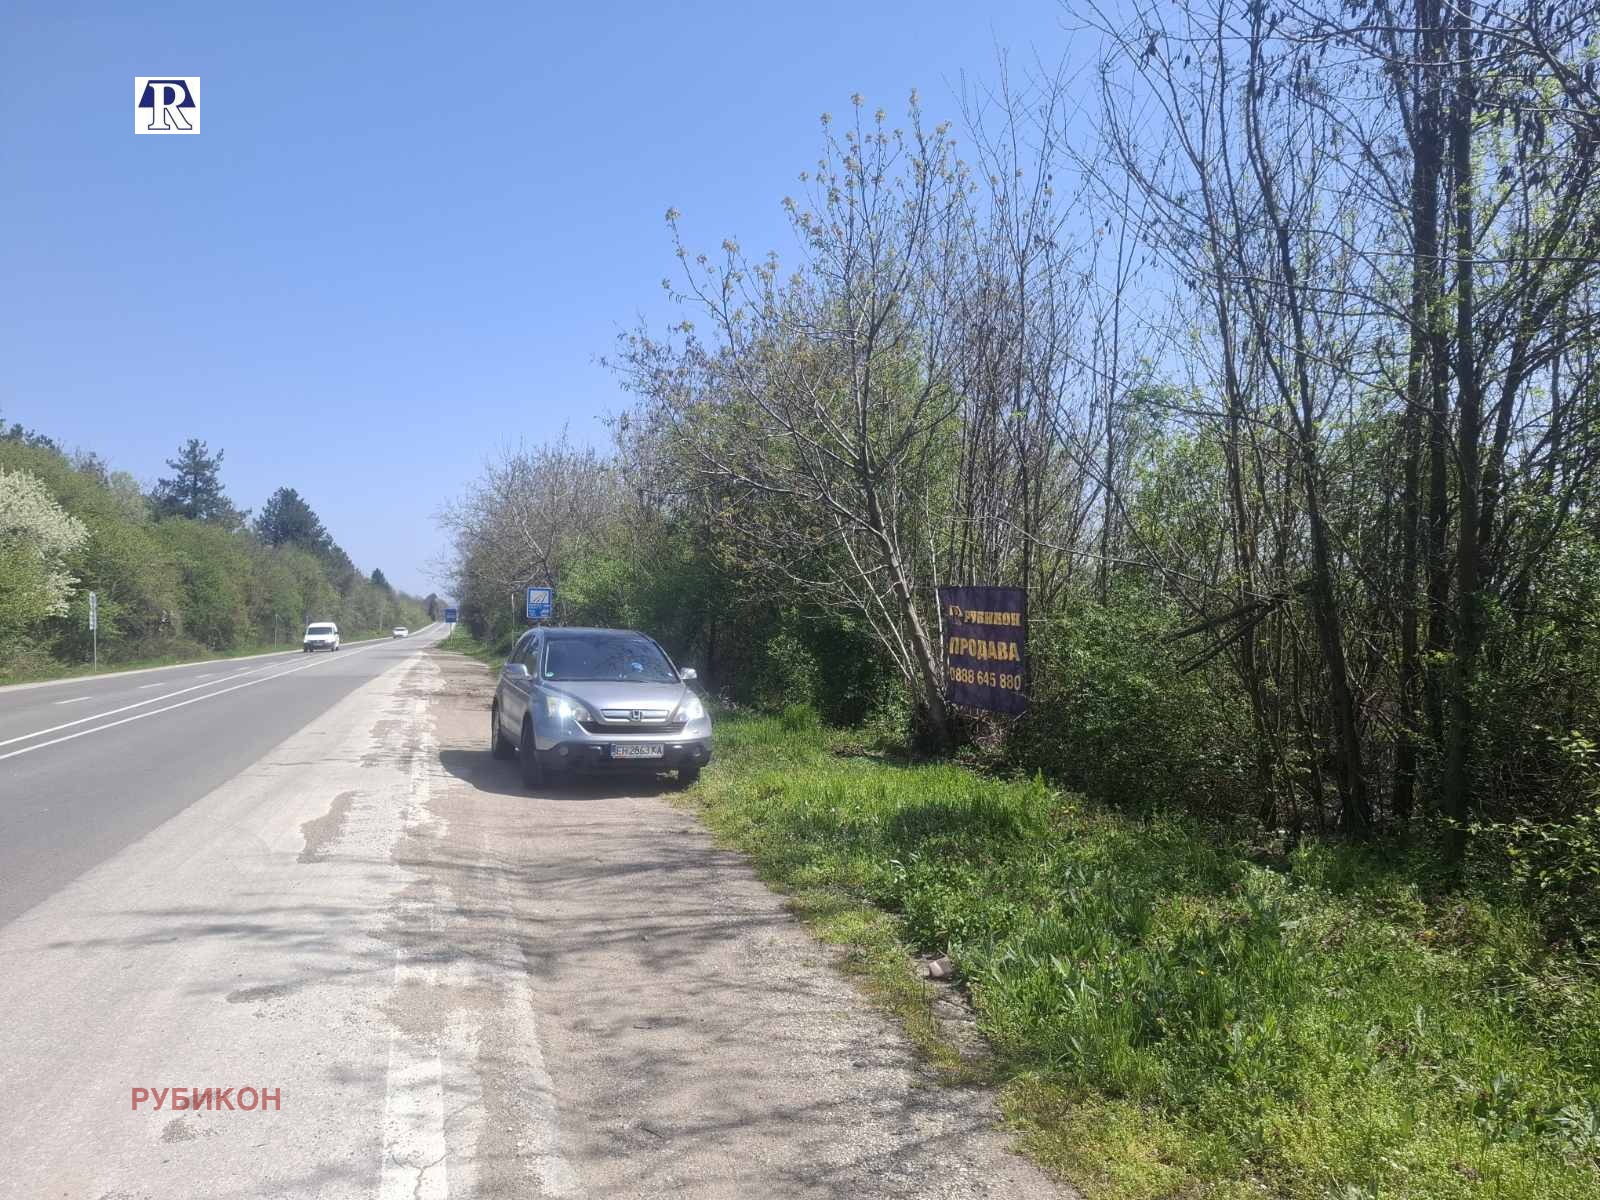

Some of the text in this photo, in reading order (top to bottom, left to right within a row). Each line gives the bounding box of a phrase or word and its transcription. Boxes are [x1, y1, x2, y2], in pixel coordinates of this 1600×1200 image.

[964, 610, 1021, 625] РУБИКОН
[949, 637, 1020, 662] ПРОДАВА
[949, 667, 1021, 690] 0888 645 880
